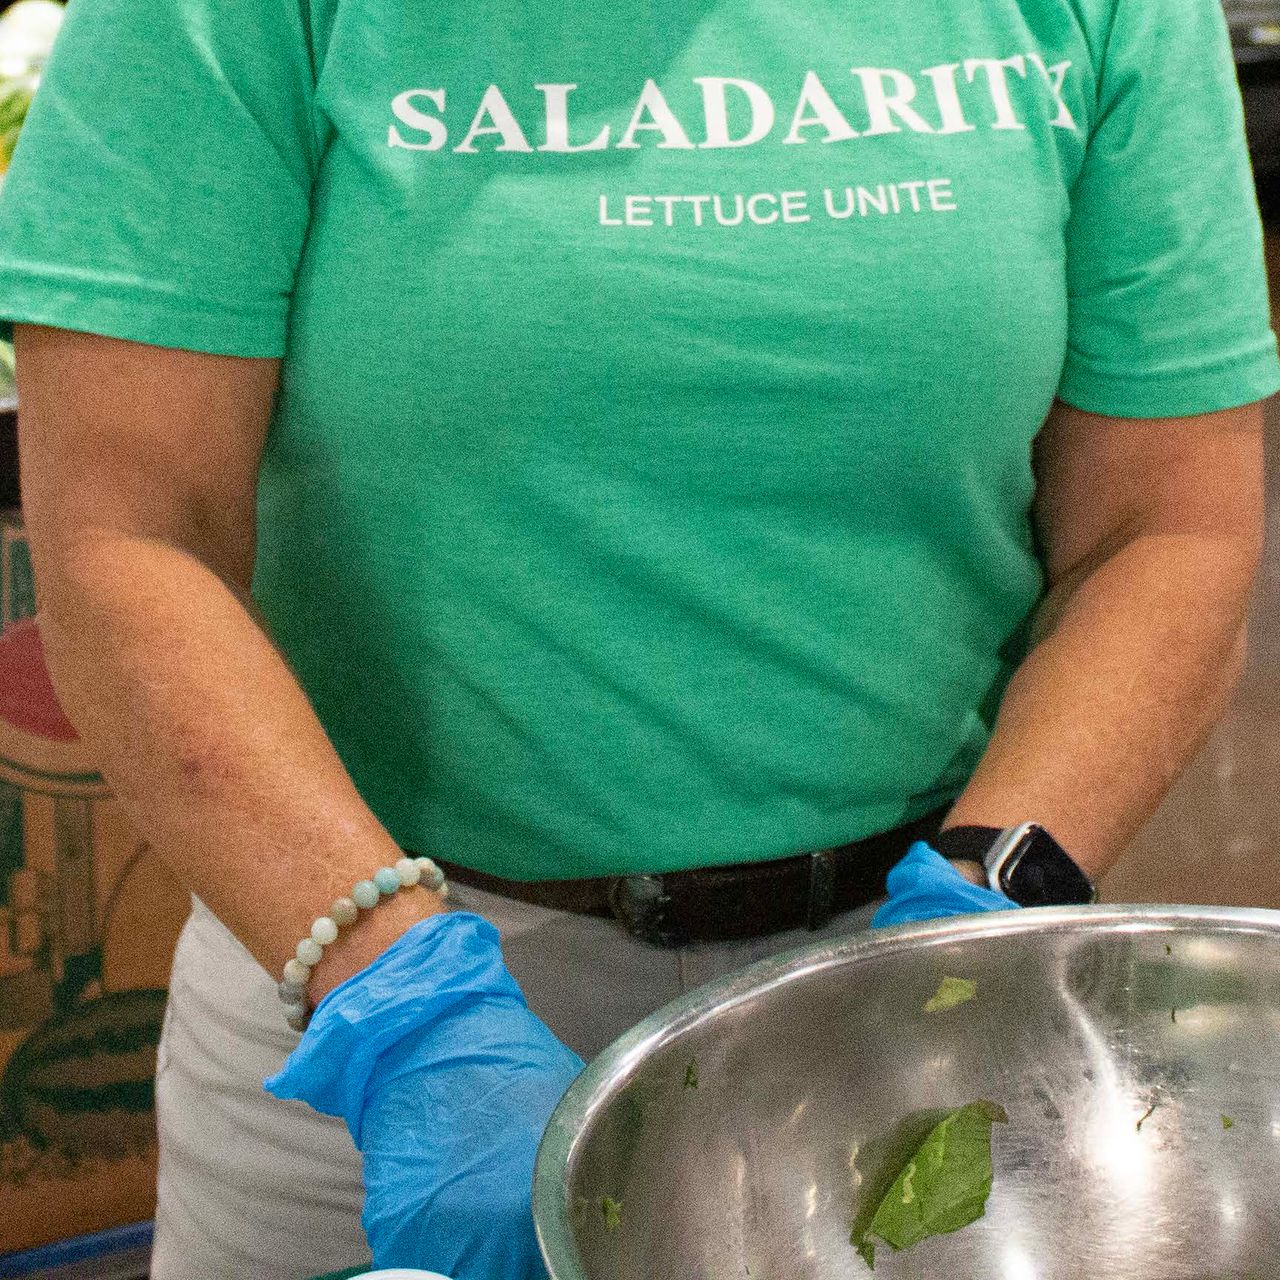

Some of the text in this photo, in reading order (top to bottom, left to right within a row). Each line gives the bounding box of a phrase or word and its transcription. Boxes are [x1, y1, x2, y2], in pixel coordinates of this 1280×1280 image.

[387, 52, 1077, 153] SALADARITY
[599, 179, 957, 226] LETTUCE UNITE
